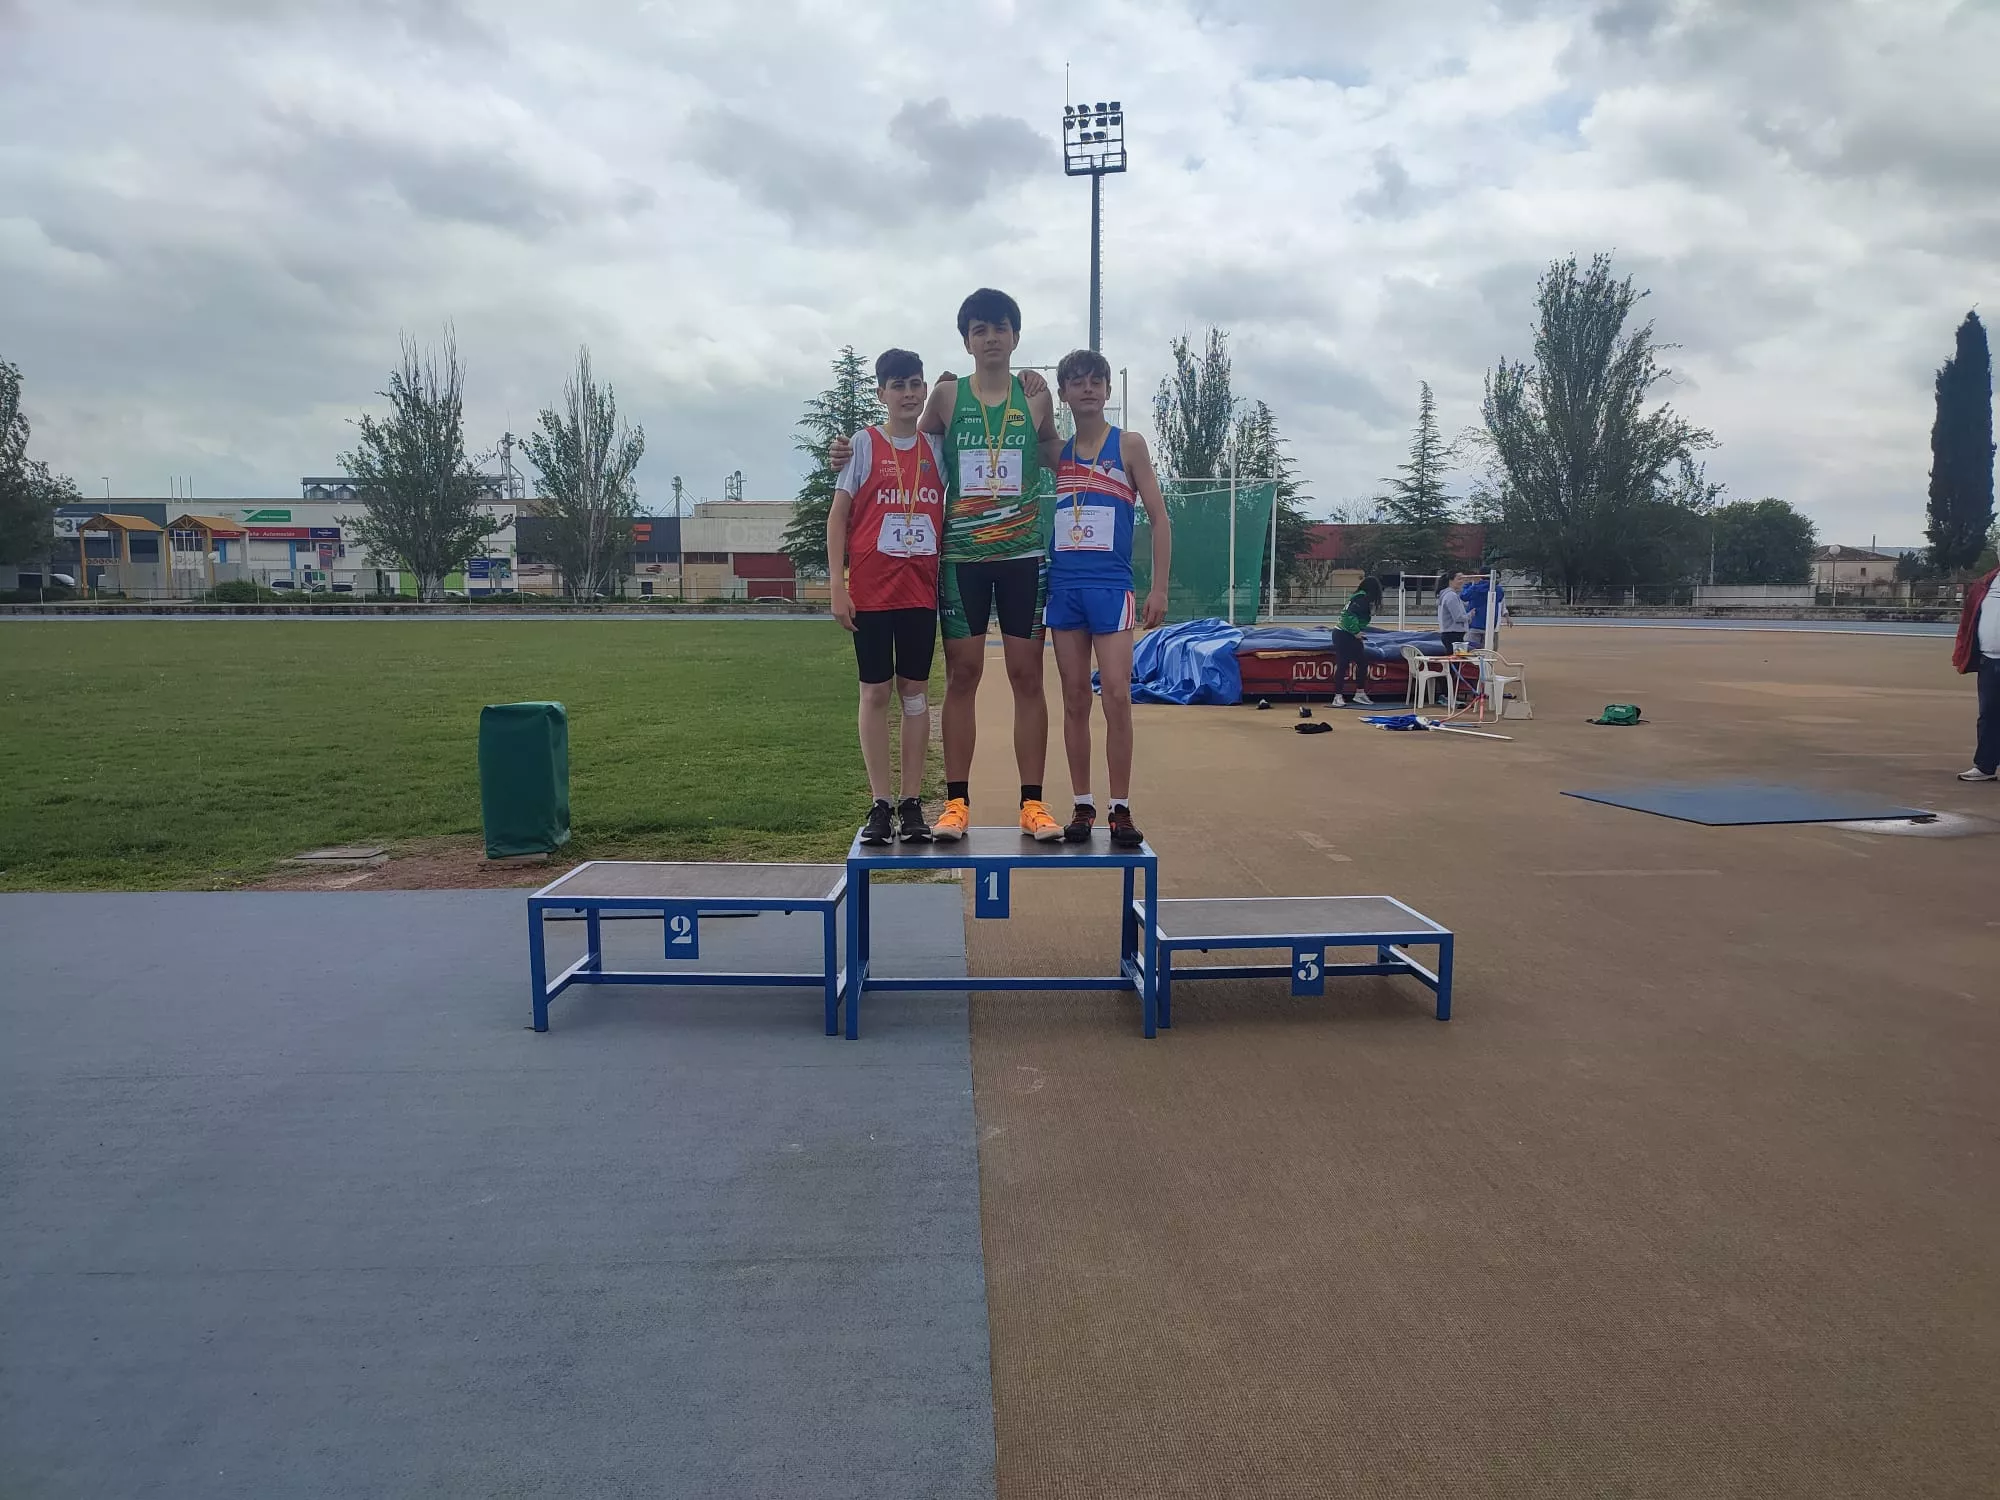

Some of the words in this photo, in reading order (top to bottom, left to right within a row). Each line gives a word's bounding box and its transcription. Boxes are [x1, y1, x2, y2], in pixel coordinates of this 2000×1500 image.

[956, 431, 1026, 446] Huesca
[974, 464, 1008, 479] 130
[877, 486, 939, 505] HINCO
[983, 871, 1000, 901] 1
[670, 915, 692, 944] 2
[1297, 953, 1319, 981] 3
